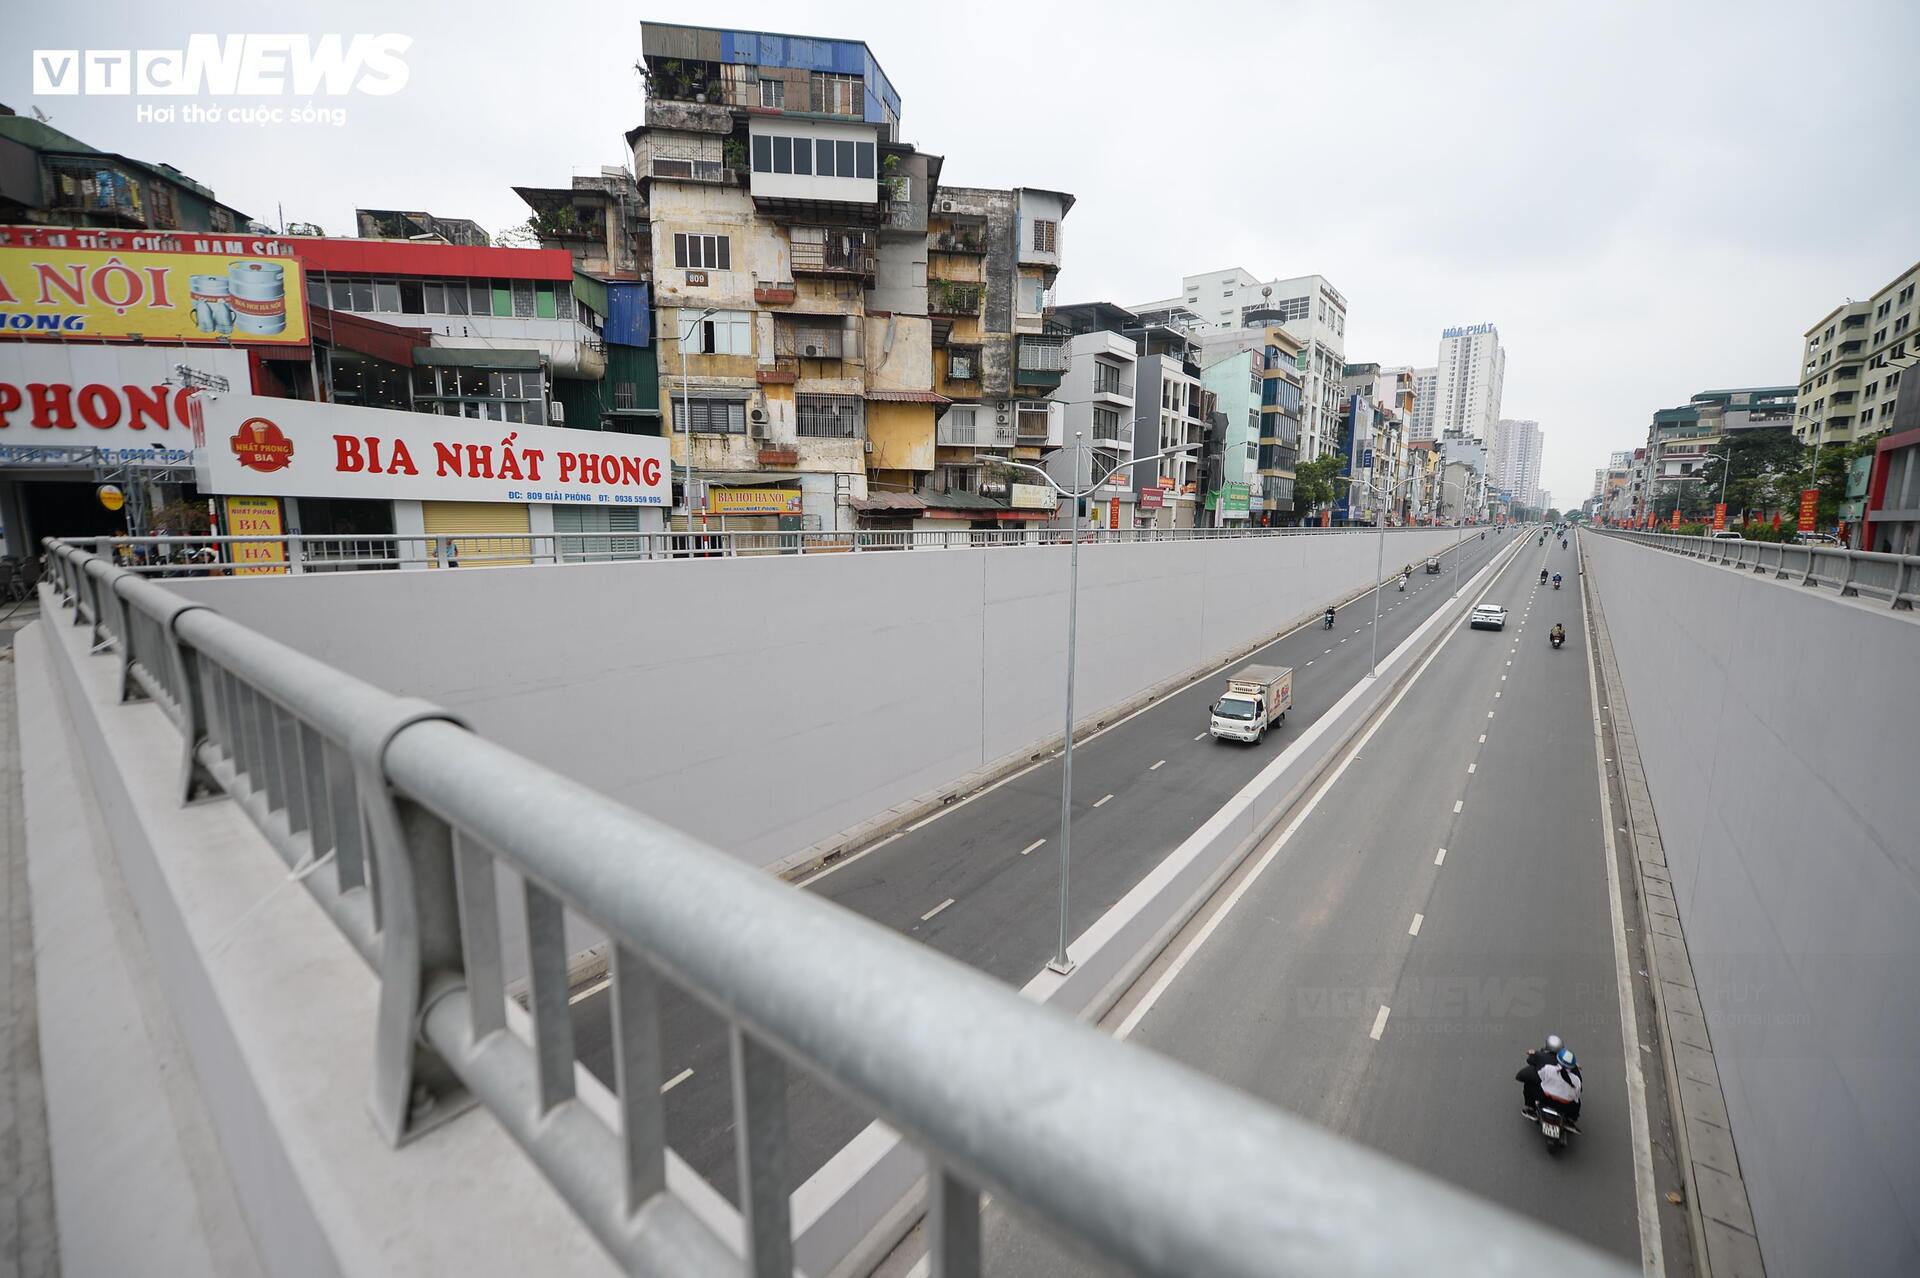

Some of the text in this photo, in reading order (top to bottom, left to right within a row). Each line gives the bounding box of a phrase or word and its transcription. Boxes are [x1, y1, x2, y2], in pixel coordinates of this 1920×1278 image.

[32, 257, 173, 314] NỘI
[260, 444, 289, 453] PHONG
[254, 453, 275, 462] BIA
[333, 432, 661, 487] BIA NHẤT PHONG
[527, 491, 543, 500] 809
[634, 495, 648, 504] 559
[718, 492, 734, 502] BIA
[239, 519, 271, 530] BIA
